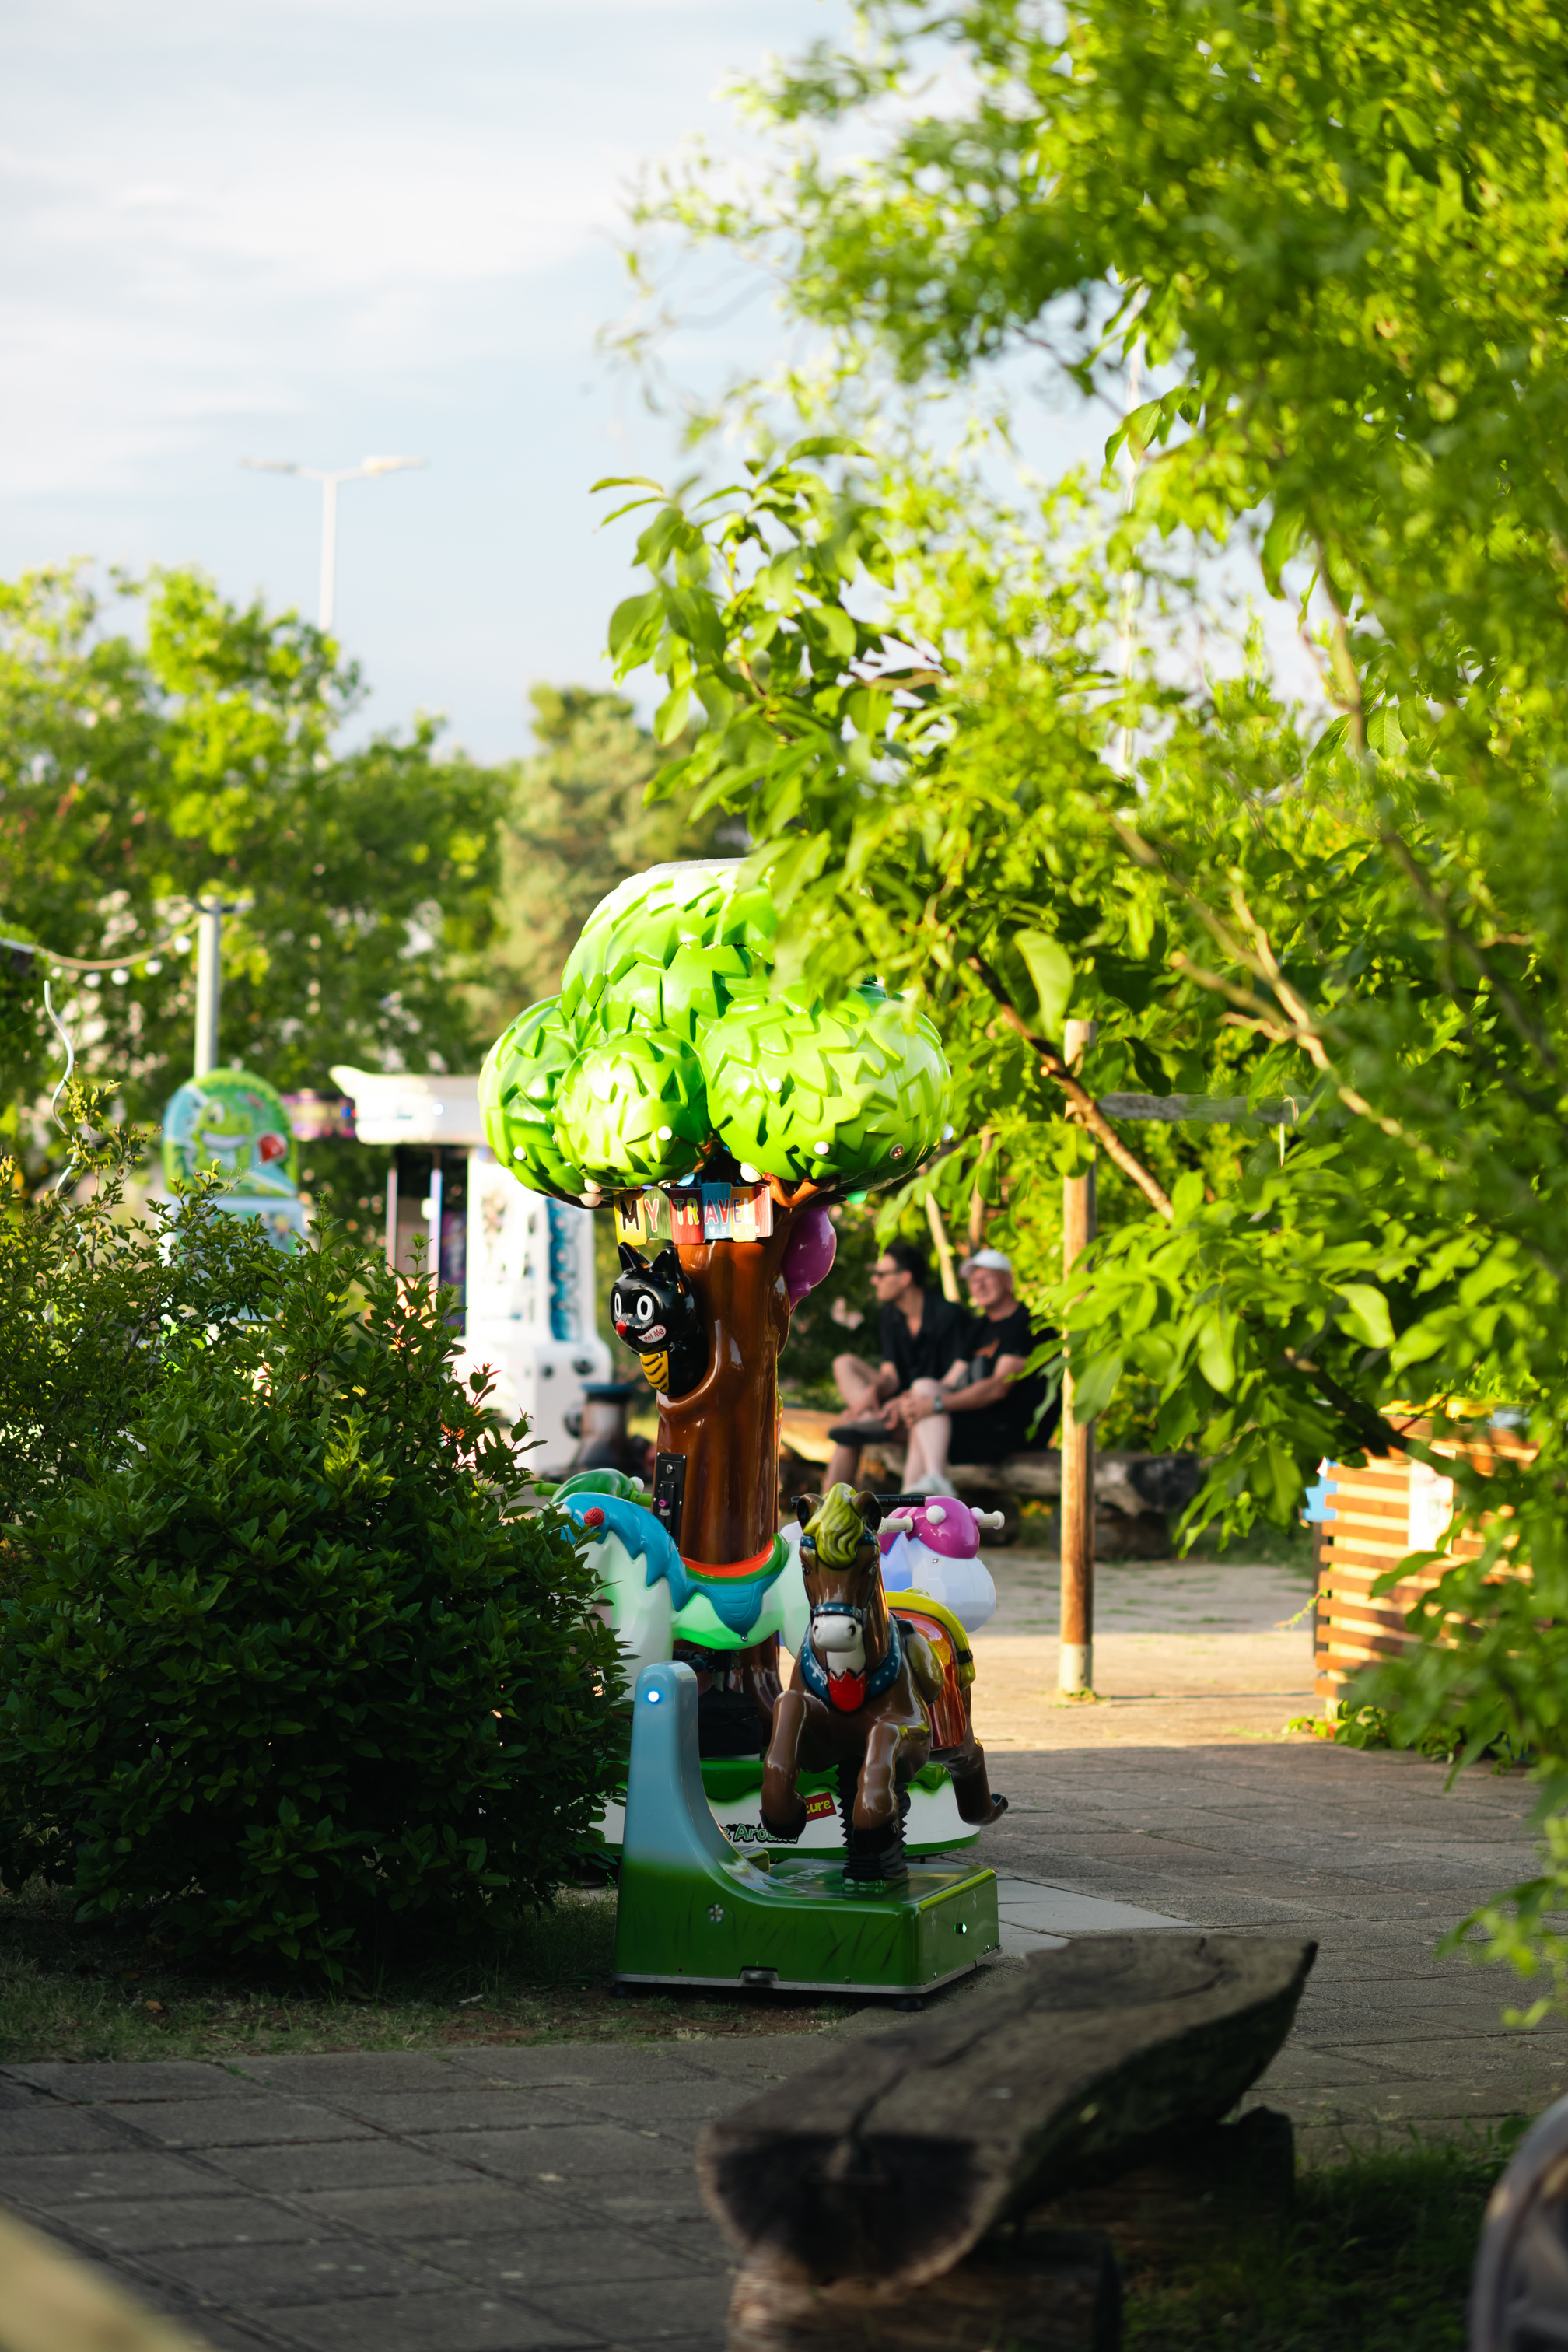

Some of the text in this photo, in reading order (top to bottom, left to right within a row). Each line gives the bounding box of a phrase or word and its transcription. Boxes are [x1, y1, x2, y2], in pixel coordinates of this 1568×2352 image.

[620, 1196, 756, 1232] MY TRAVEL
[709, 1226, 761, 1234] WORLD
[653, 1328, 665, 1338] Me
